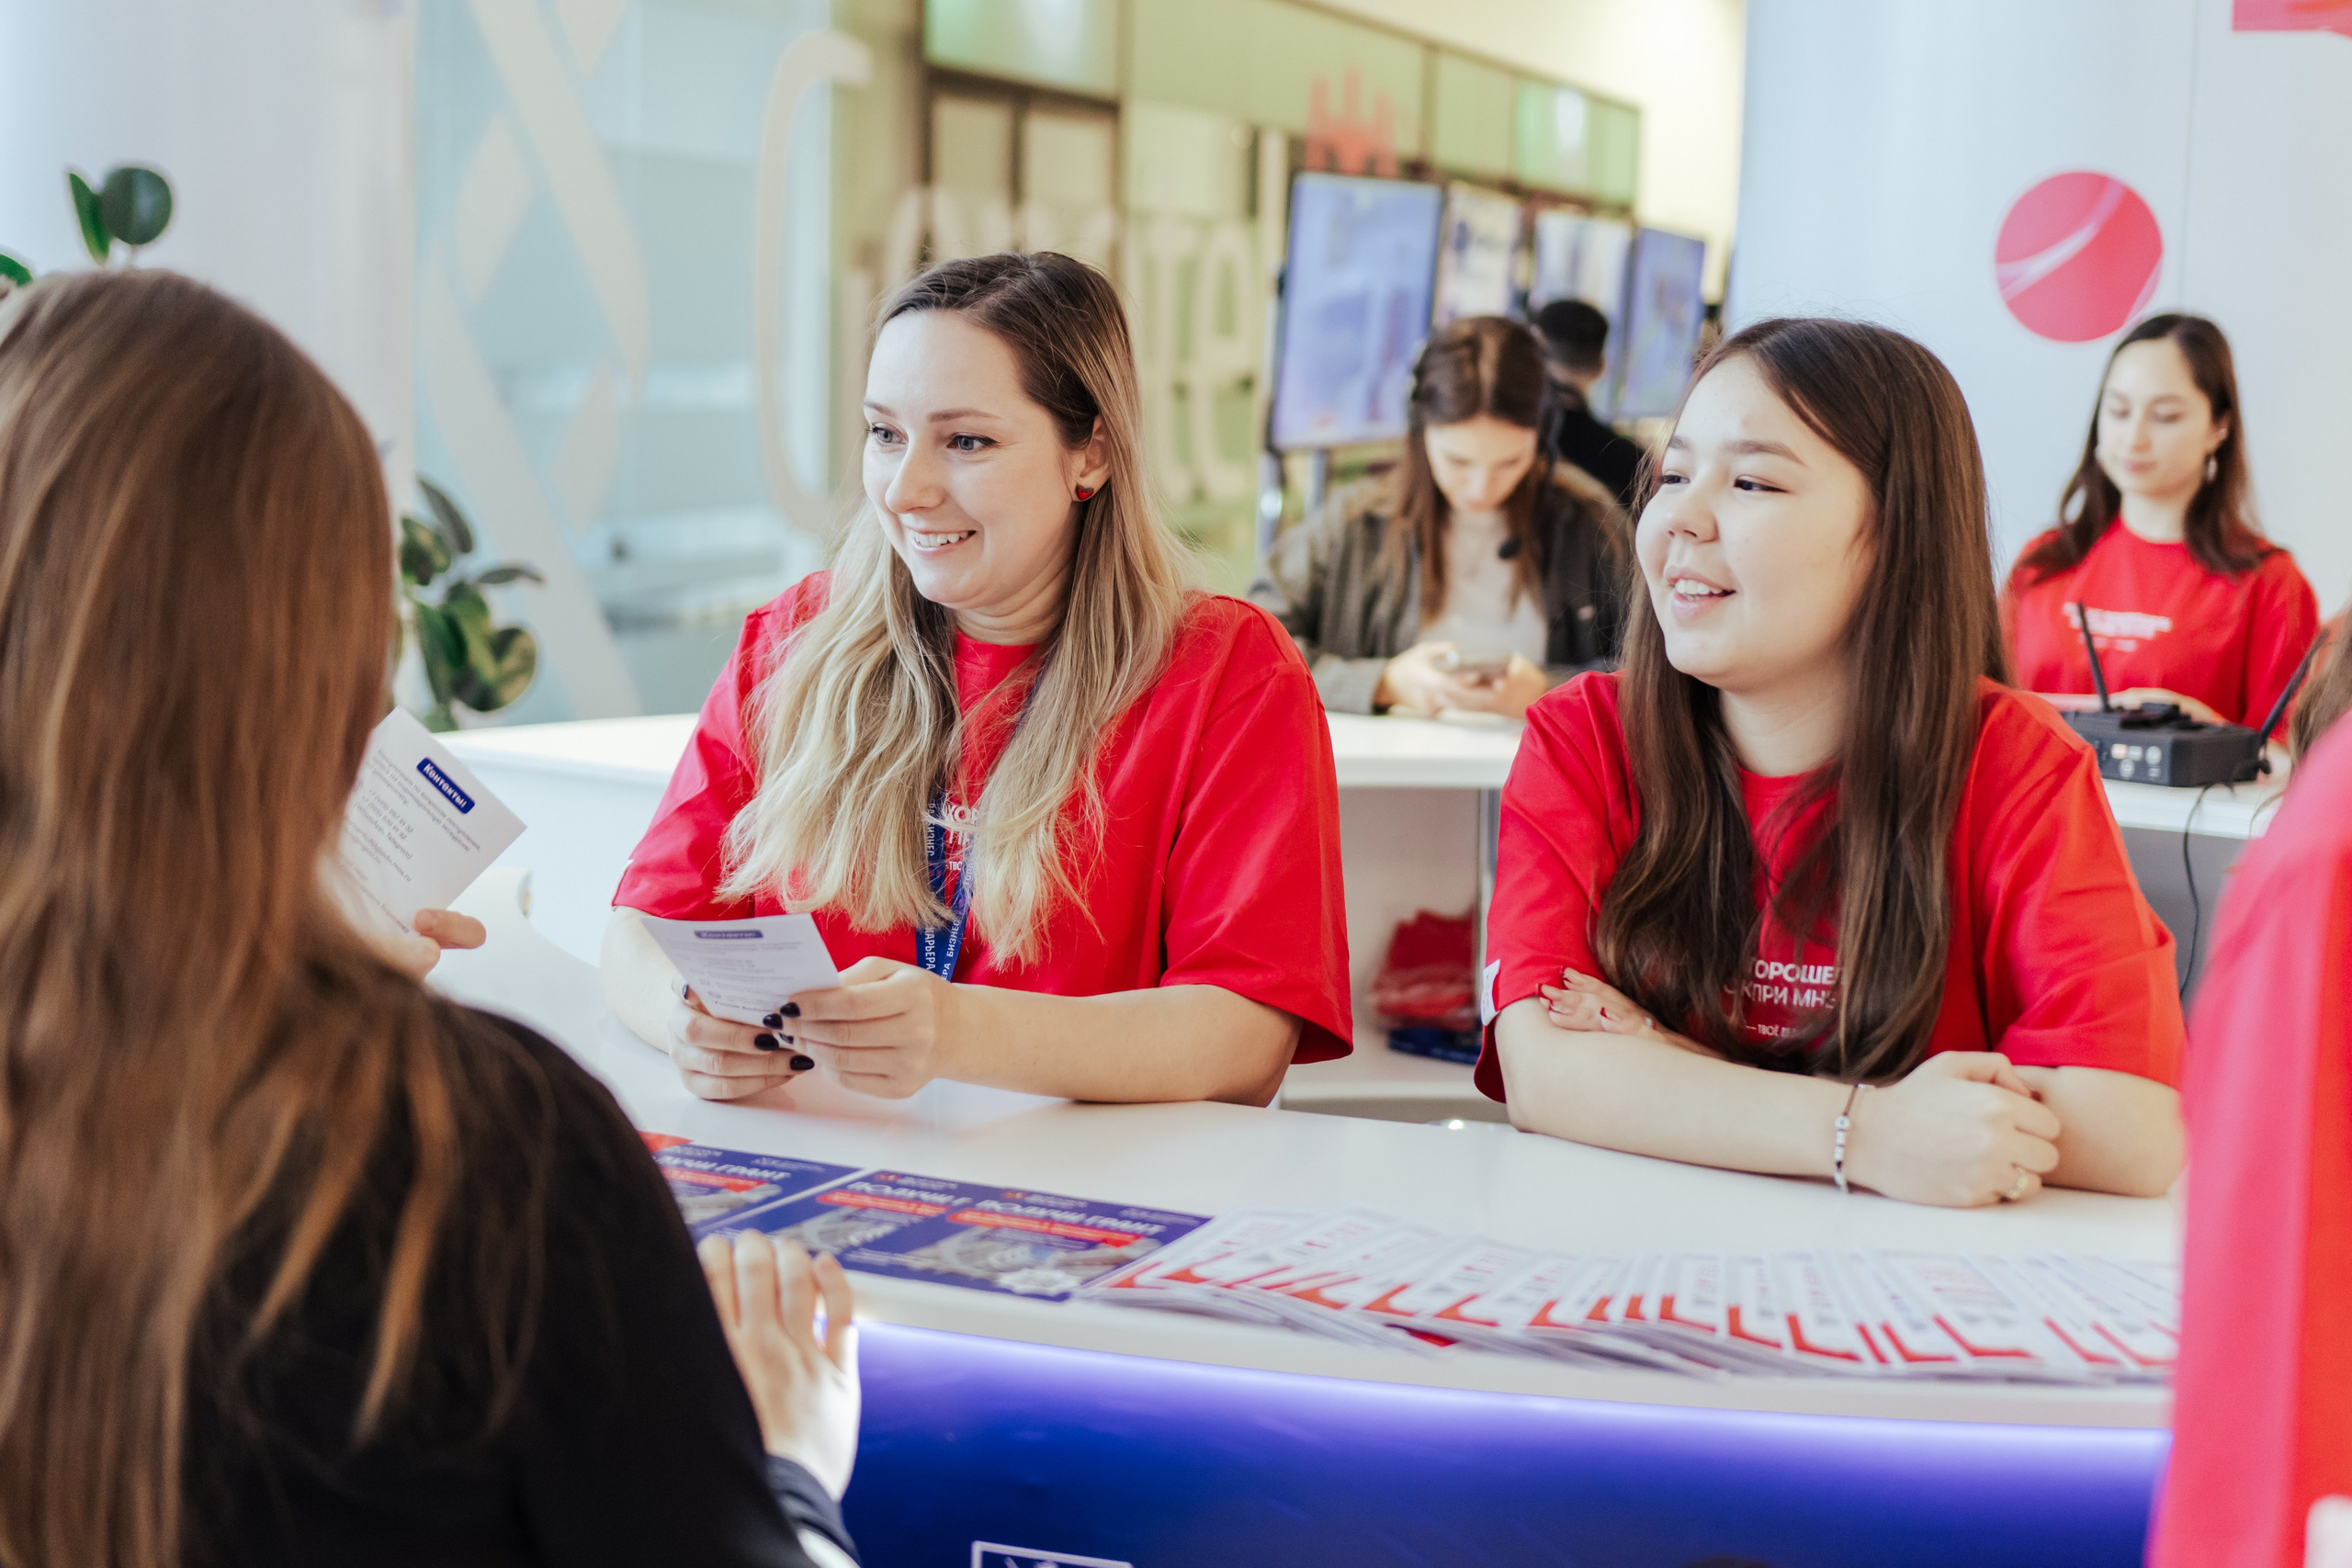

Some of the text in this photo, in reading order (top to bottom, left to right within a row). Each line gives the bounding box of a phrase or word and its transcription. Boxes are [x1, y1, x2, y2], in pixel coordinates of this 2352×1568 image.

[946, 919, 960, 957] БИЗНЕС
[941, 963, 952, 980] ЕРА
[1754, 959, 1837, 985] ОРОШЕ
